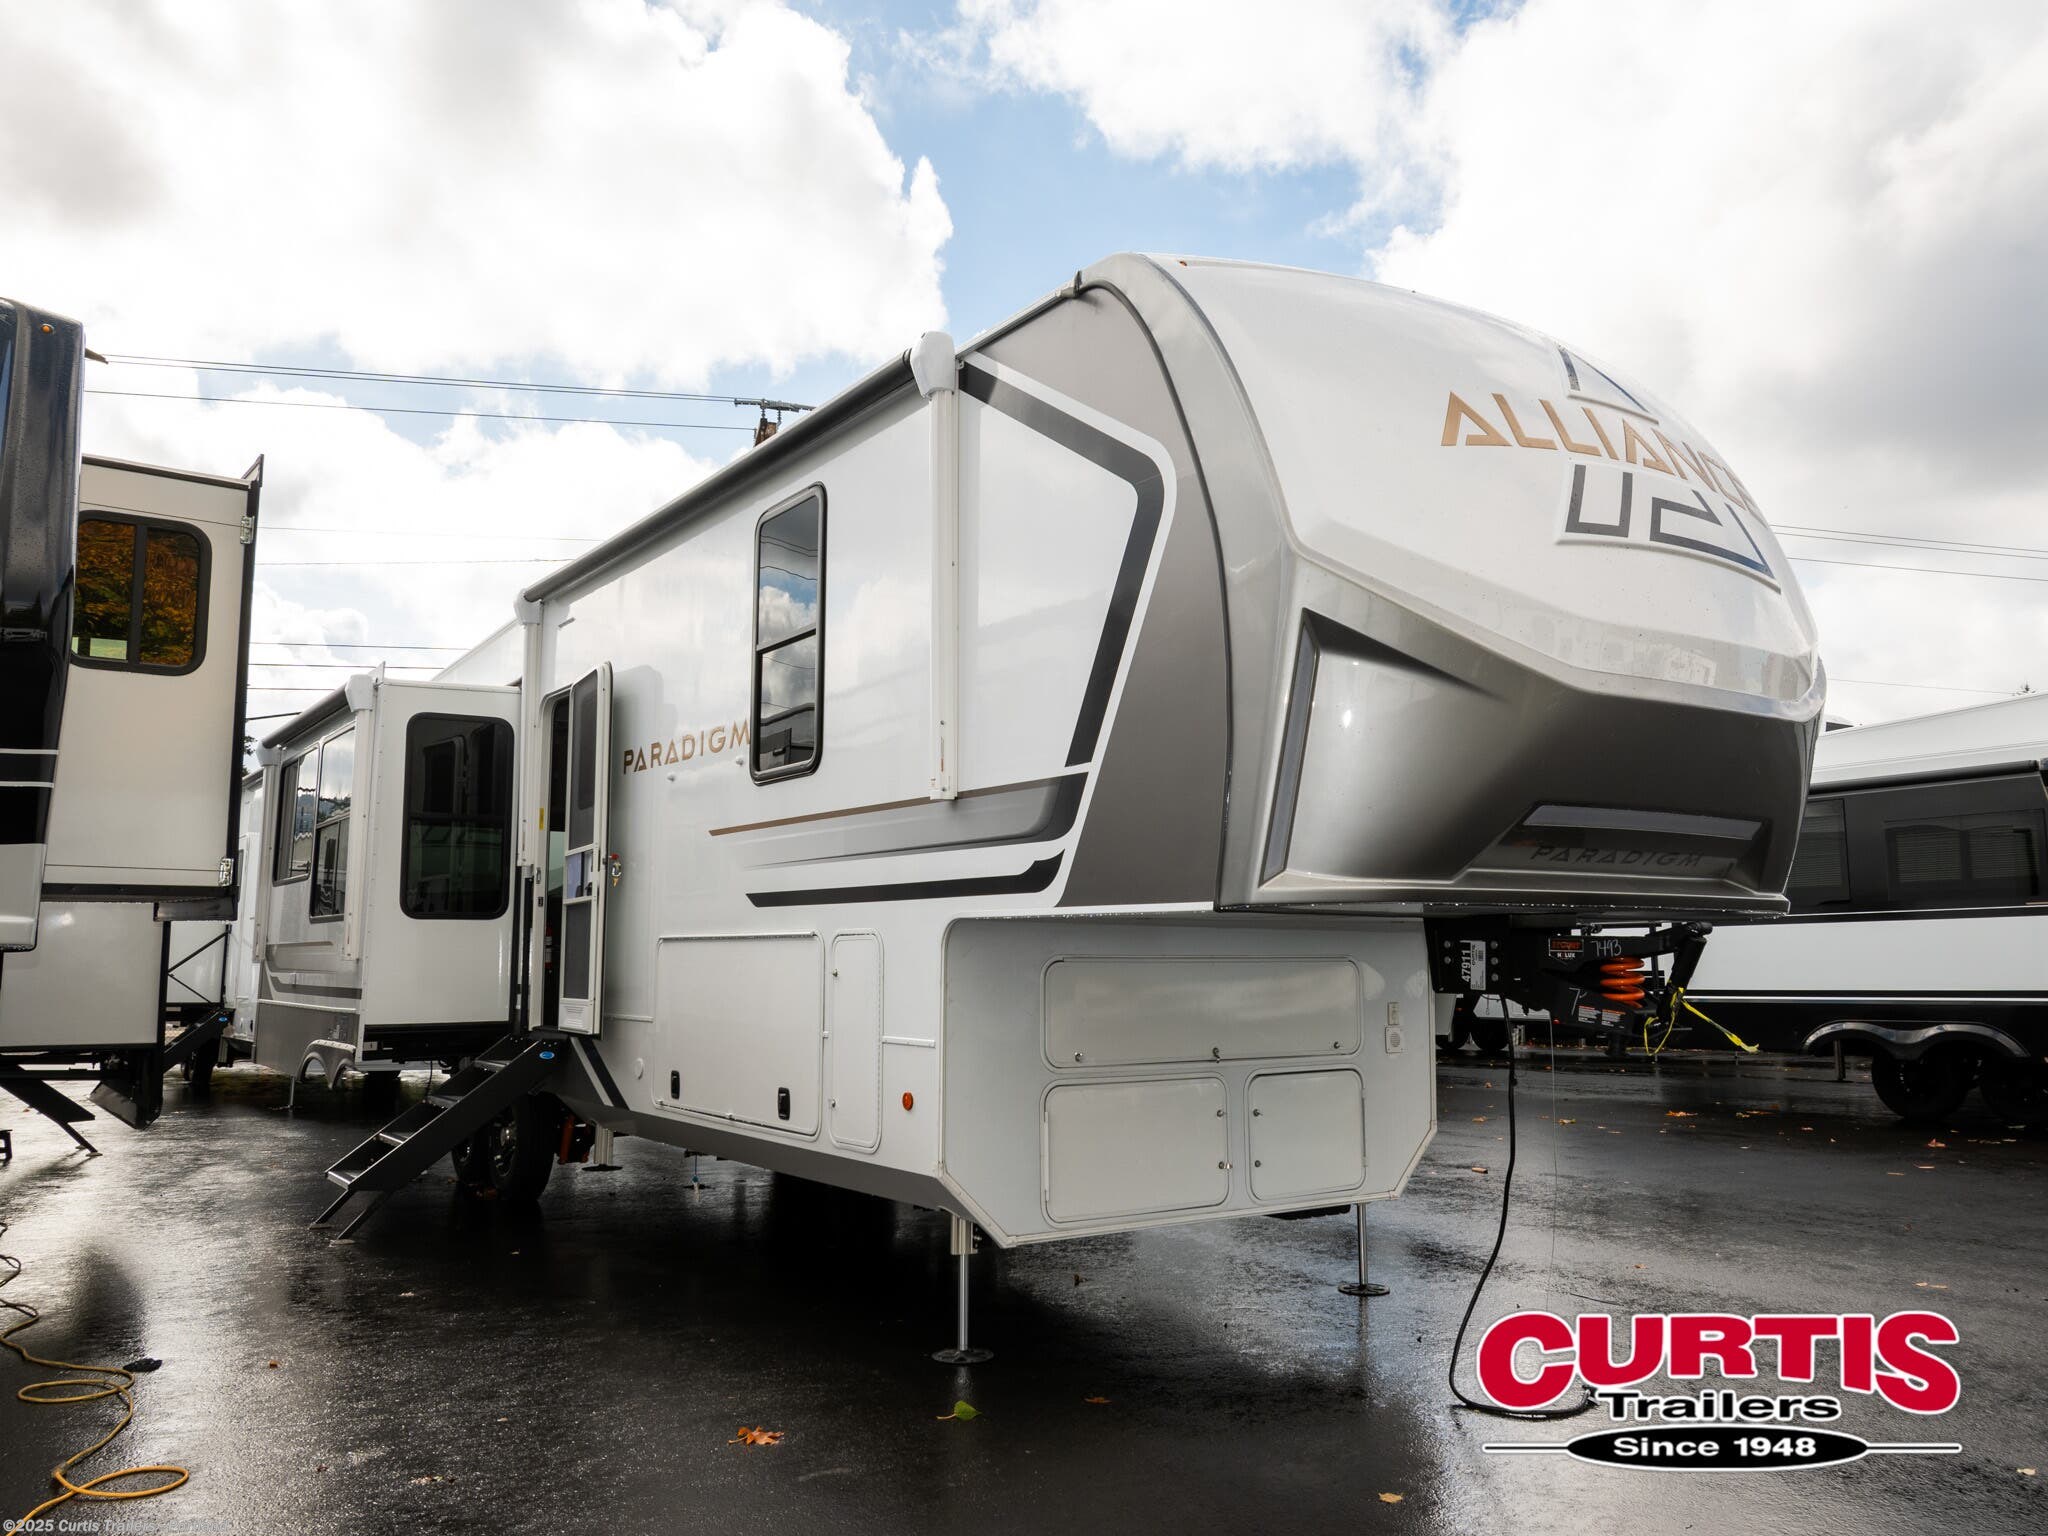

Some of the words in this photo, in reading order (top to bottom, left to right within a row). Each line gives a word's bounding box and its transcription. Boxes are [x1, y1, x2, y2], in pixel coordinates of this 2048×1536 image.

[623, 720, 751, 775] PARADIGM
[1528, 844, 1705, 868] PARADIGM
[1461, 950, 1471, 983] 47911
